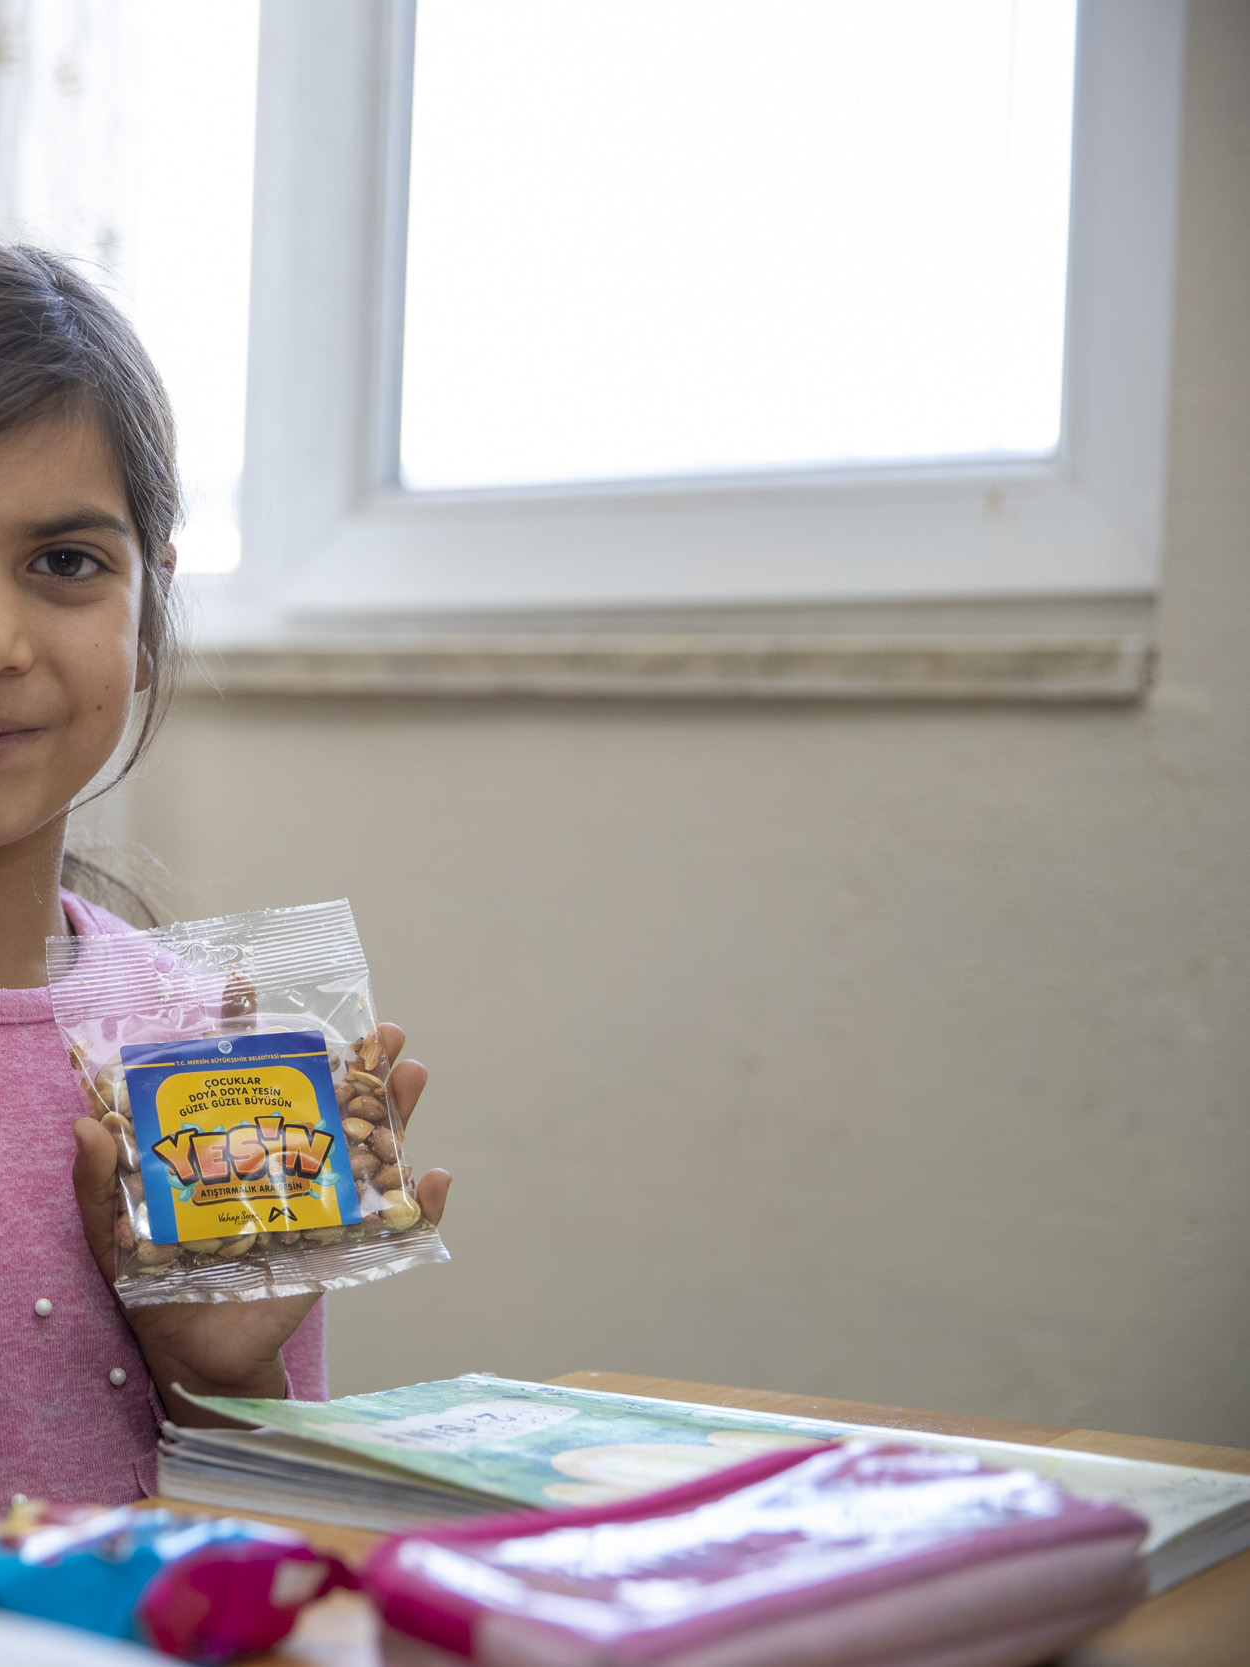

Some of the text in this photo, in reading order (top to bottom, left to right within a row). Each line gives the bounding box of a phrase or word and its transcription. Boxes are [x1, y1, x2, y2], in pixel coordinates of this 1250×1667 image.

[187, 1057, 210, 1066] MERSİN
[211, 1055, 248, 1064] BÜYÜKŞEHİR
[248, 1052, 280, 1062] BELEDİYESİ
[204, 1077, 261, 1089] ÇOCUKLAR
[188, 1086, 281, 1103] DOYA DOYA YESİN
[179, 1095, 292, 1117] GÜZEL GÜZEL BÜYÜSÜN
[151, 1116, 334, 1187] YESİN
[201, 1185, 257, 1198] ATIŞTIRMALIK
[259, 1184, 276, 1192] ARA
